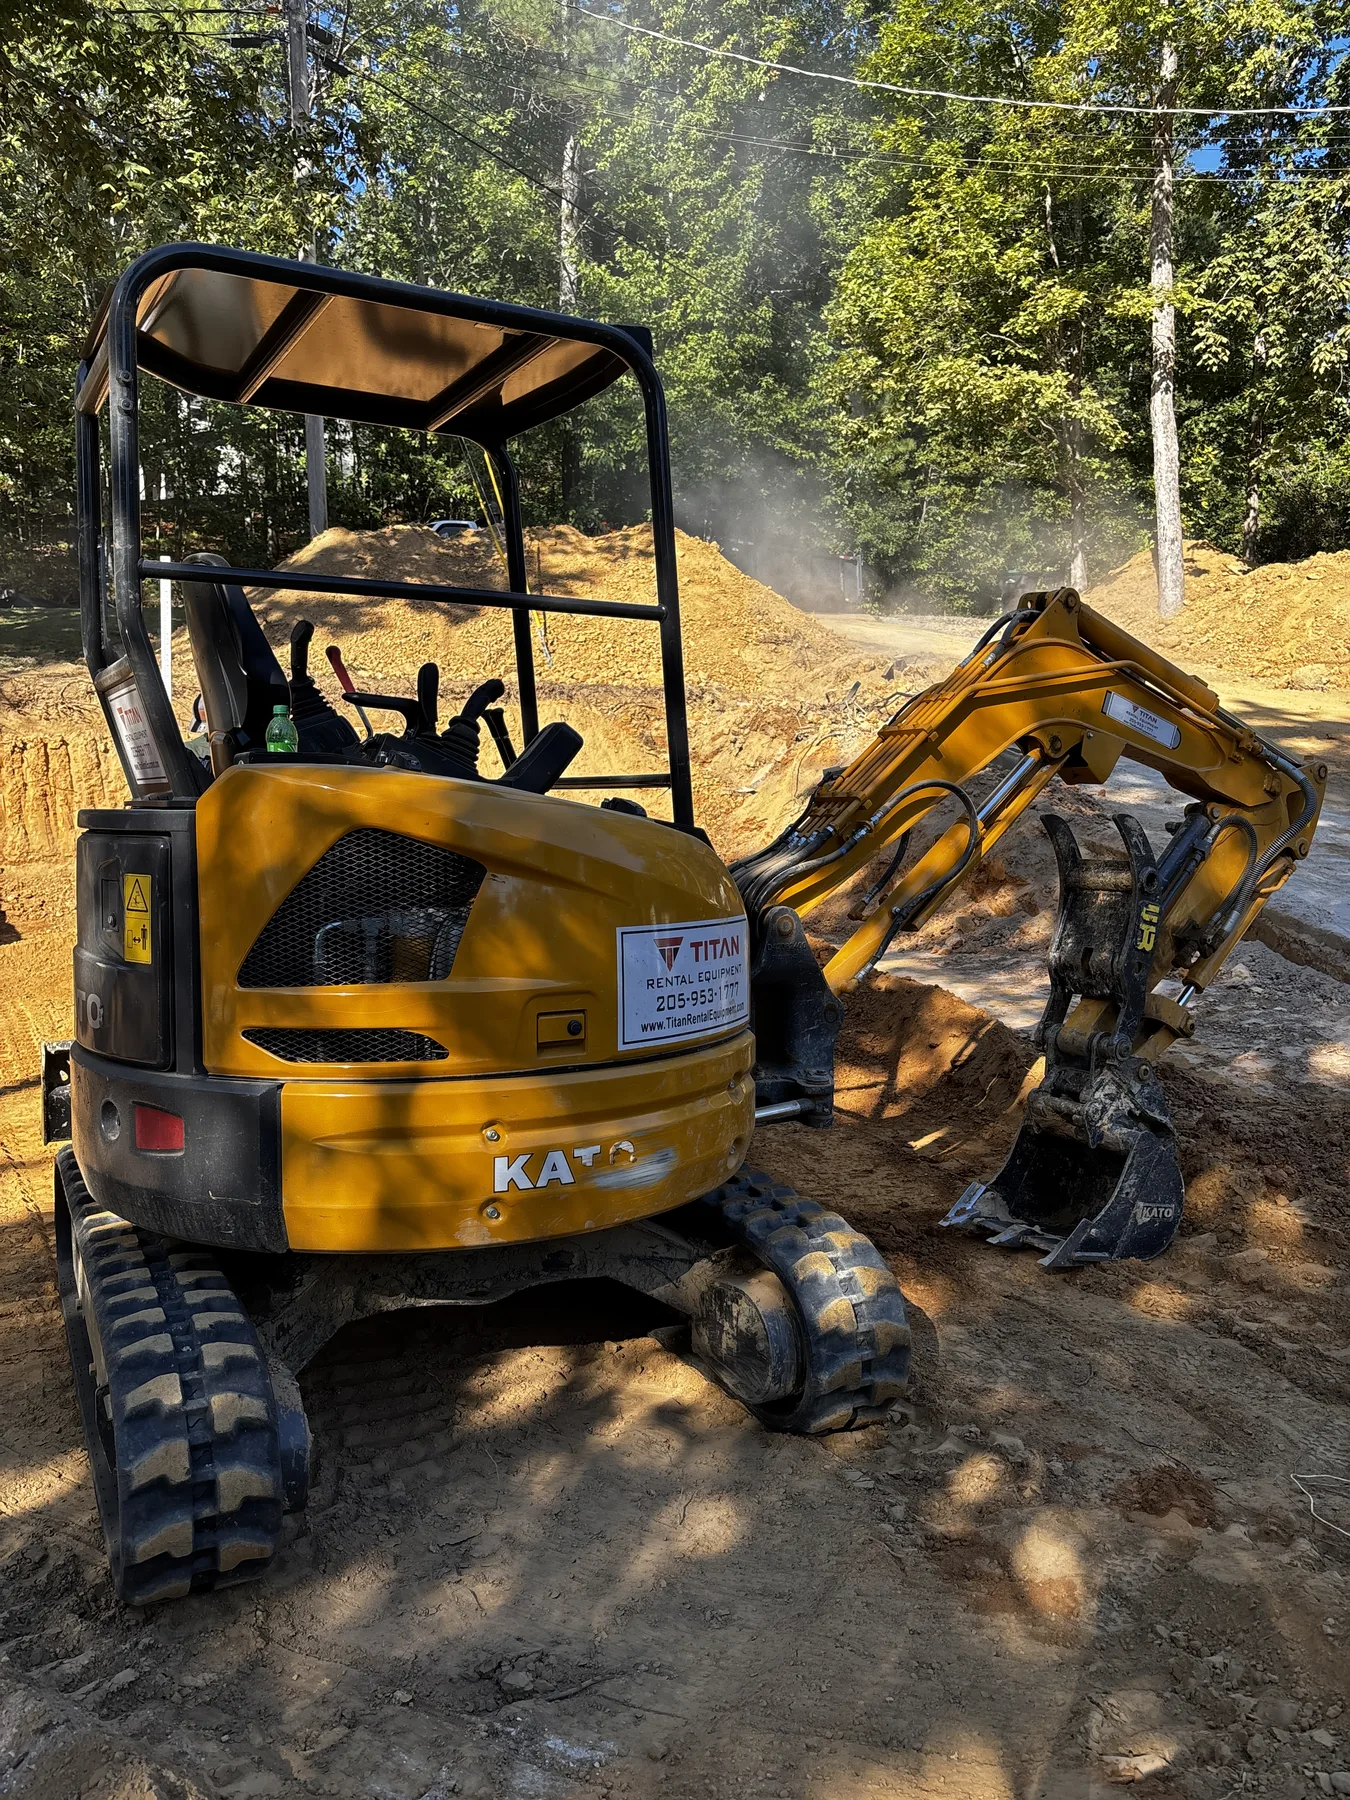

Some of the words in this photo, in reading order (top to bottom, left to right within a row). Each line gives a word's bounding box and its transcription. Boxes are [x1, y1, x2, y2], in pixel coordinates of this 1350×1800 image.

[1139, 710, 1158, 724] TITAN
[690, 935, 740, 962] TITAN
[646, 973, 694, 990] RENTAL
[698, 963, 743, 983] EQUIPMENT
[656, 981, 740, 1012] 205-953-1777
[640, 1002, 745, 1033] www.TitanRentalEquipment.com
[1142, 1206, 1173, 1219] KATO
